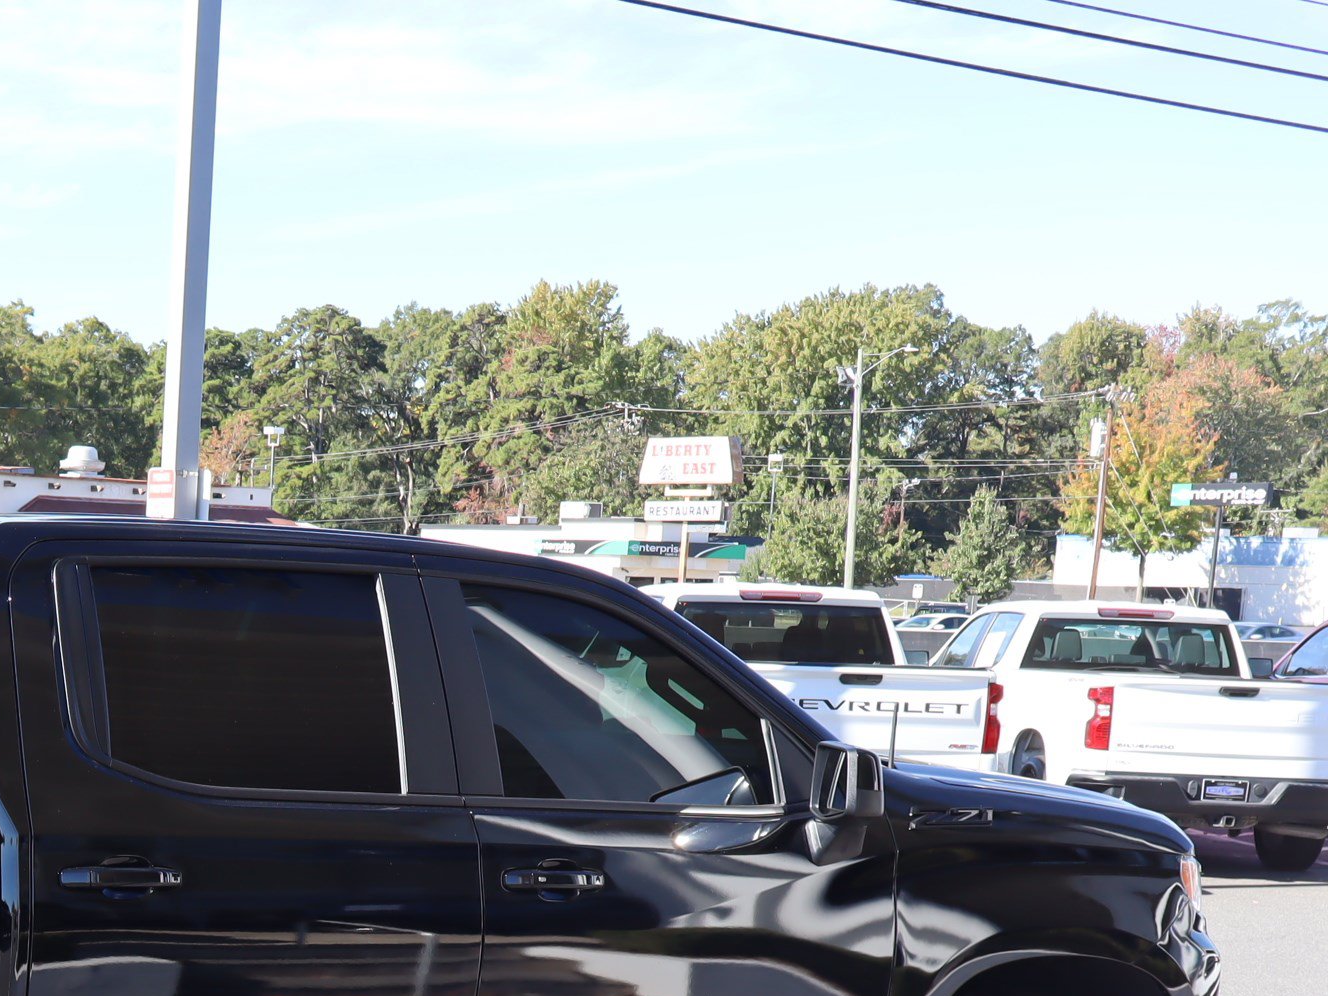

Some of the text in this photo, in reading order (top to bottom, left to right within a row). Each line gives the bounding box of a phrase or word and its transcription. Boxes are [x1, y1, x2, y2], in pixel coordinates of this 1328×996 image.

[652, 444, 712, 456] LIBERTY
[682, 462, 716, 474] EAST
[1174, 486, 1267, 503] enterprise
[649, 506, 716, 516] RESTAURANT
[630, 544, 680, 554] enterpris
[791, 698, 969, 714] EVROLET
